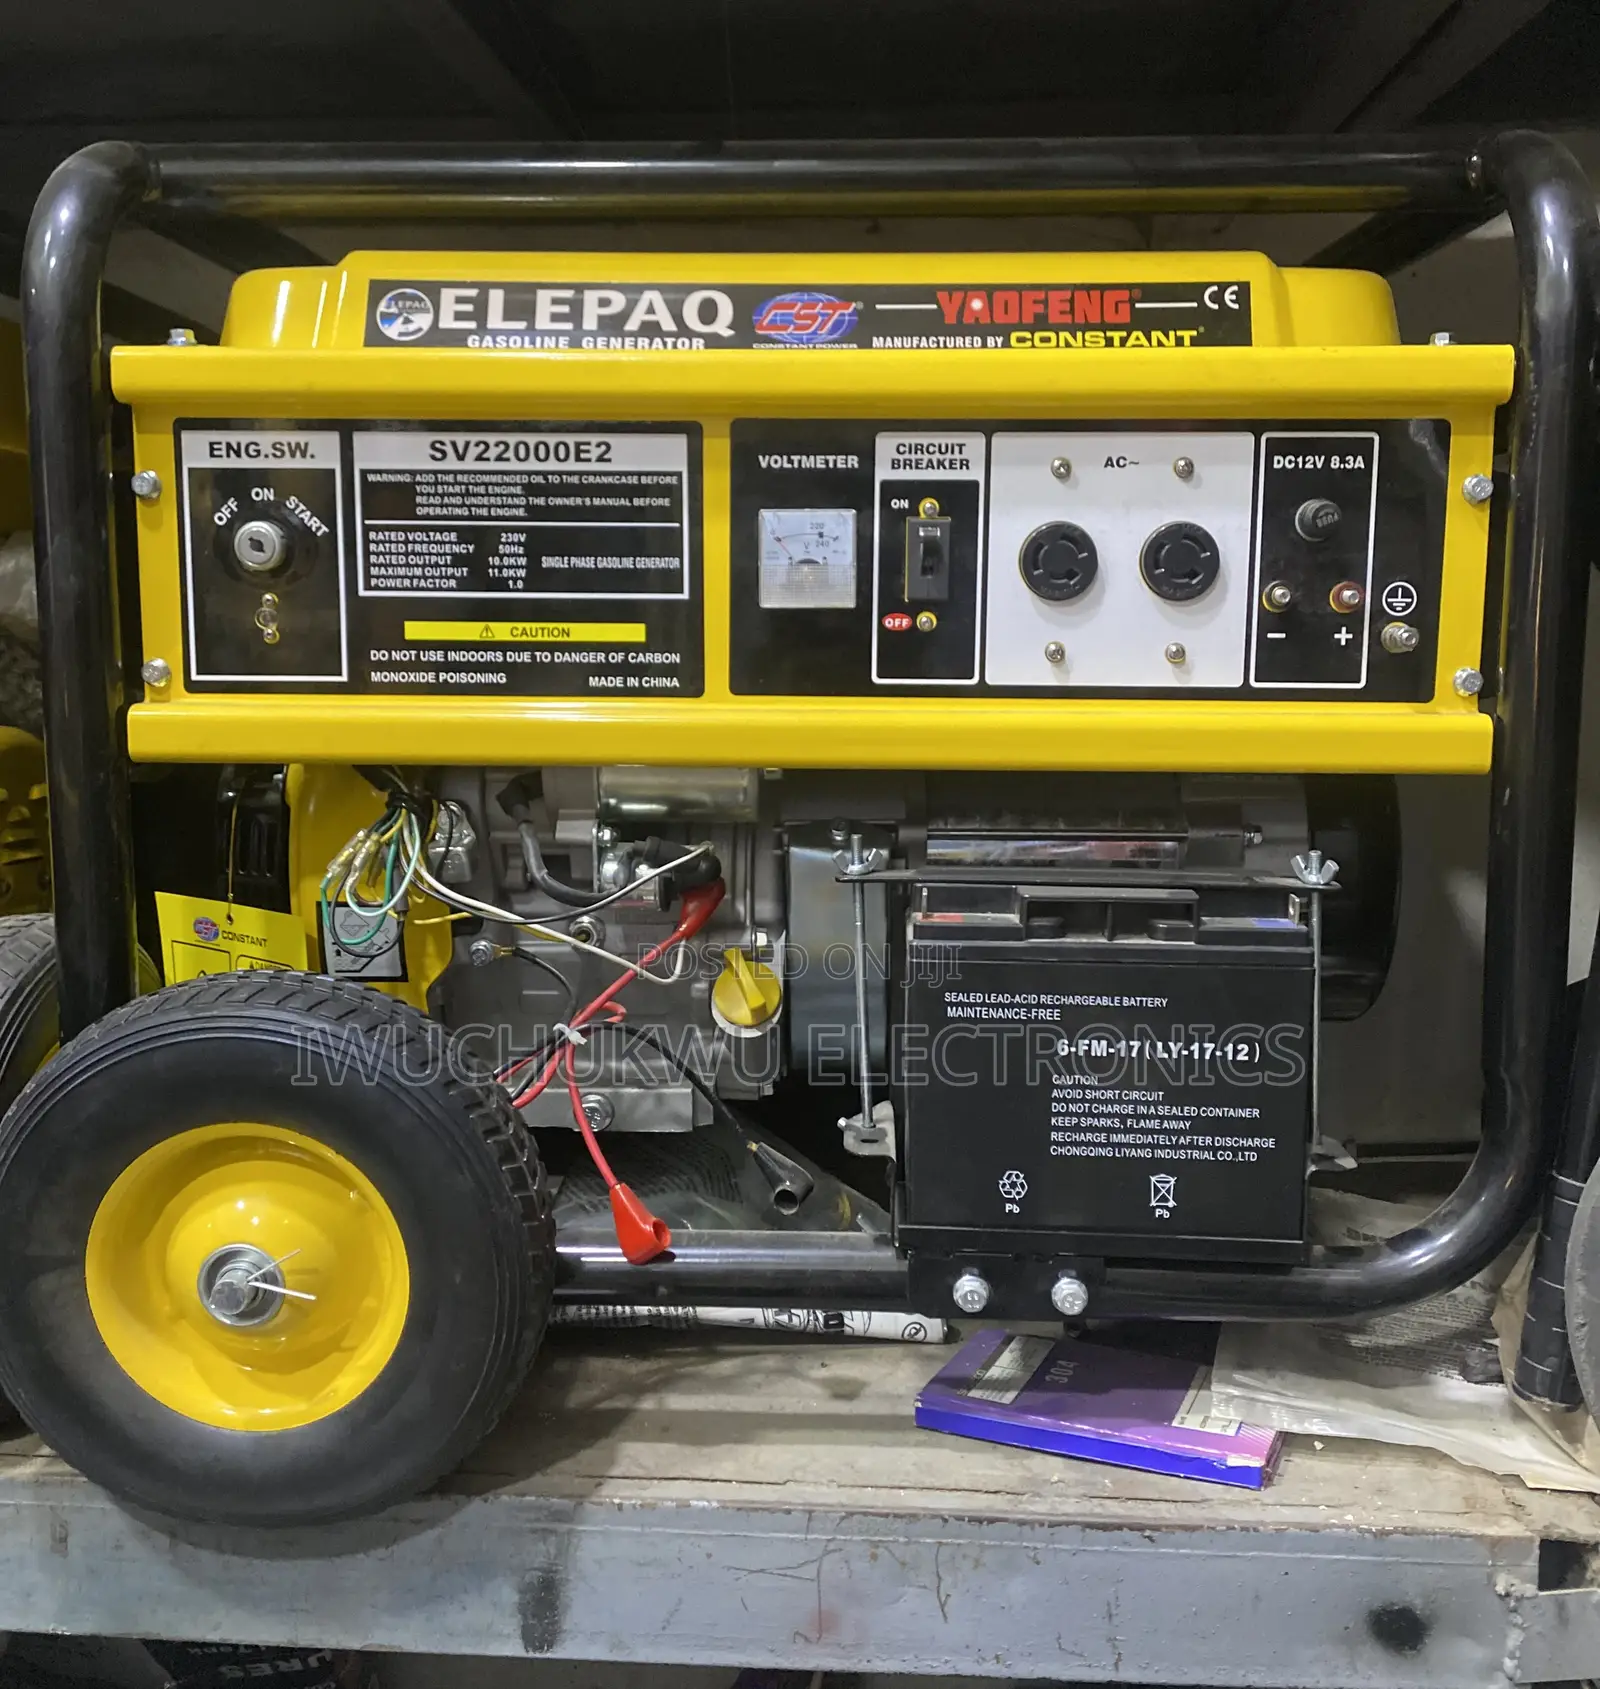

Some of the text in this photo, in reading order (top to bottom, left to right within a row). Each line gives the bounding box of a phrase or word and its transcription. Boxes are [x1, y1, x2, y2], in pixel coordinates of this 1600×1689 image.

[438, 287, 736, 337] ELEPAQ
[937, 289, 1132, 325] YAOFENG
[754, 301, 857, 334] CST
[467, 334, 707, 351] GASOLINE GENERATOR
[872, 336, 1005, 350] MANUFACTURED BY
[1009, 330, 1199, 348] CONSTANT
[208, 441, 316, 460] ENG.SW.
[428, 439, 613, 463] SV22000E2
[896, 443, 966, 456] CIRCUIT
[758, 454, 859, 469] VOLTMETER
[891, 458, 971, 471] BREAKER
[1273, 455, 1366, 470] DC12V 8.3A
[367, 474, 678, 484] WARNING: ADD THE RECOMMENDED OIL TO THE CRANKCASE BEFORE
[250, 487, 275, 502] ON
[415, 485, 524, 494] YOU START THE ENGINE.
[415, 496, 670, 506] READ AND UNDERSTAND THE OWNER'S MANUAL BEFORE
[891, 499, 909, 510] ON
[213, 497, 241, 527] OFF
[285, 495, 330, 538] START
[416, 507, 528, 516] OPERATING THE ENGINE.
[369, 532, 527, 543] RATED VOLTAGE 230V
[369, 544, 525, 555] RATED FREQUENCY 50Hz
[370, 555, 527, 566] RATED OUTPUT 10.0KW
[541, 556, 679, 569] SINGLE PHASE GASOLINE GENERATOR
[370, 567, 527, 578] MAXIMUM OUTPUT 11.0KW
[371, 579, 524, 590] POWER FACTOR 1.0
[885, 617, 910, 629] OFF
[510, 626, 571, 639] CAUTION
[370, 650, 680, 665] DO NOT USE INDOORS DUE TO DANGER OF CARBON
[371, 671, 505, 684] MONOXIDE POISONING
[589, 676, 679, 688] MADE IN CHINA
[221, 930, 268, 948] CONSTANT
[945, 991, 1167, 1008] SEALED LEAD-ACID RECHARGEABLE BATTERY
[947, 1007, 1062, 1021] MAINTENANCE-FREE
[1052, 1075, 1099, 1086] CAUTION
[1052, 1089, 1163, 1102] AVOID SHORT CIRCUIT
[1051, 1103, 1259, 1119] DO NOT CHARGE IN A SEALED CONTAINER
[1051, 1117, 1190, 1131] KEEP SPARKS, FLAME AWAY
[1051, 1132, 1275, 1149] RECHARGE IMMEDIATELY AFTER DISCHARGE
[1050, 1146, 1257, 1162] CHONGQING LIYANG INDUSTRIAL CO.,LTD
[1005, 1202, 1020, 1214] Pb
[1155, 1208, 1170, 1220] Pb
[1046, 1359, 1080, 1384] 304
